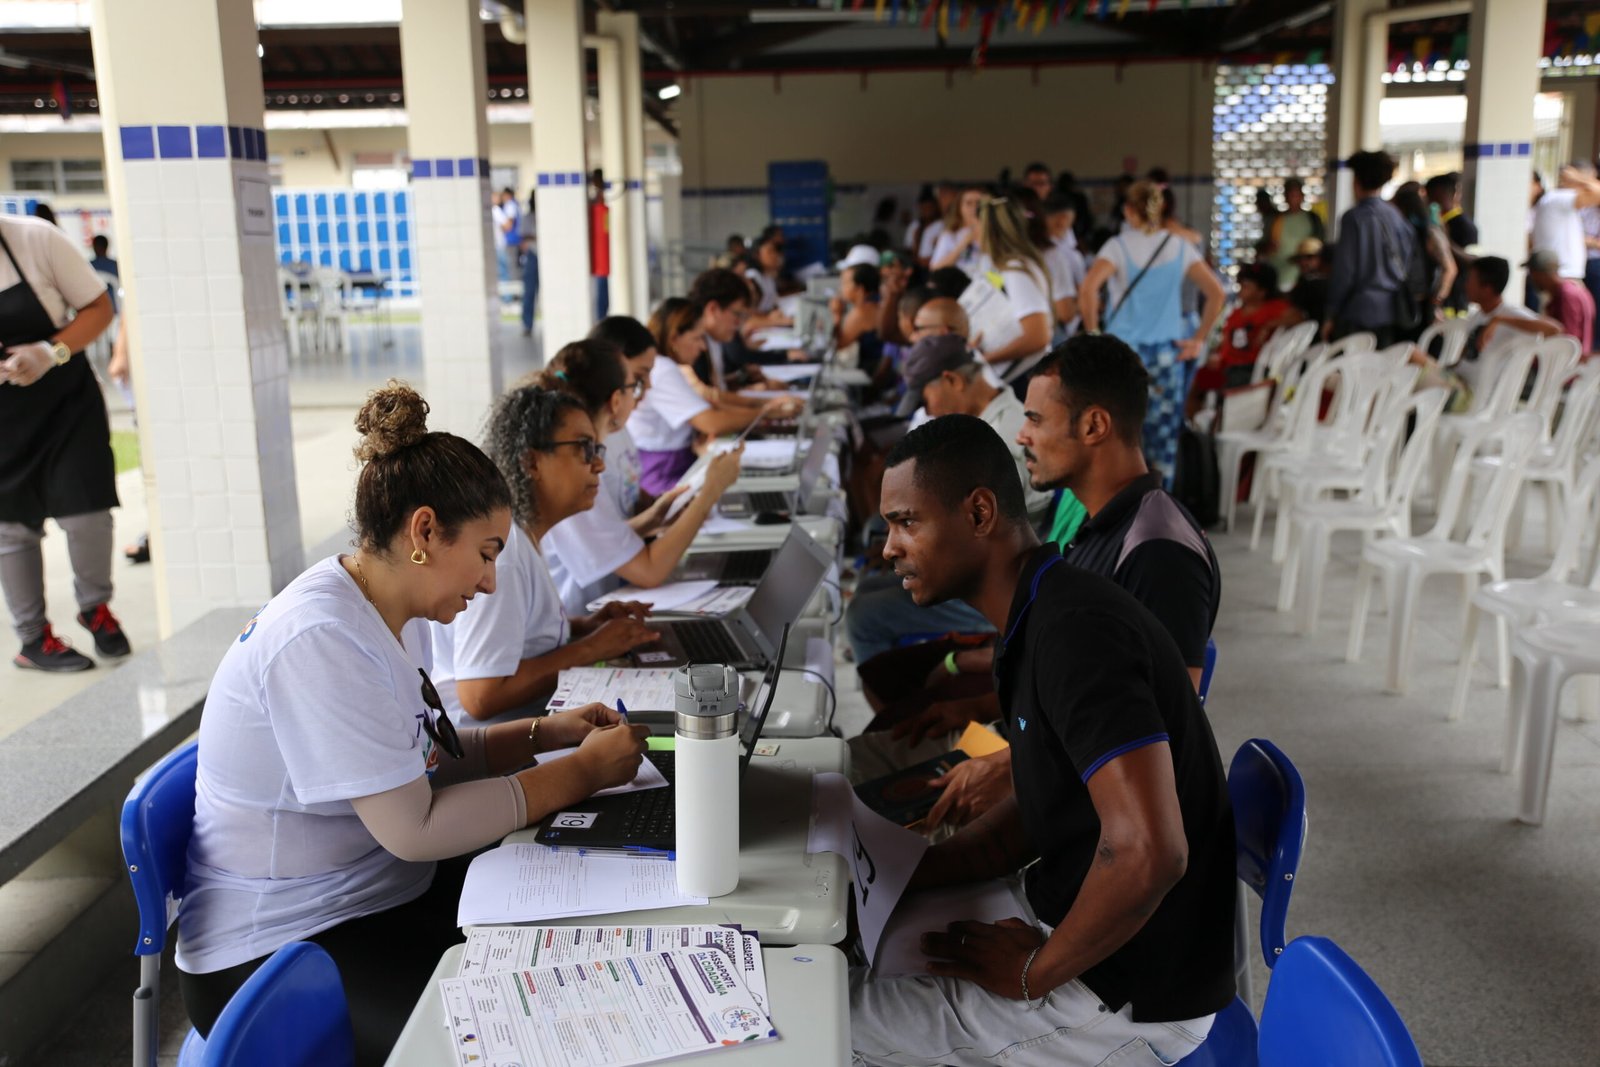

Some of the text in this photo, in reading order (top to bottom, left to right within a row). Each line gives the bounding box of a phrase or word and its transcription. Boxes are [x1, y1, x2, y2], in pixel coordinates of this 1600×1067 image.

[560, 814, 588, 826] 19
[696, 952, 708, 961] DA
[707, 950, 736, 988] PASSAPORTE
[743, 937, 754, 971] PASSAPORTE
[701, 960, 728, 996] CIDADANIA
